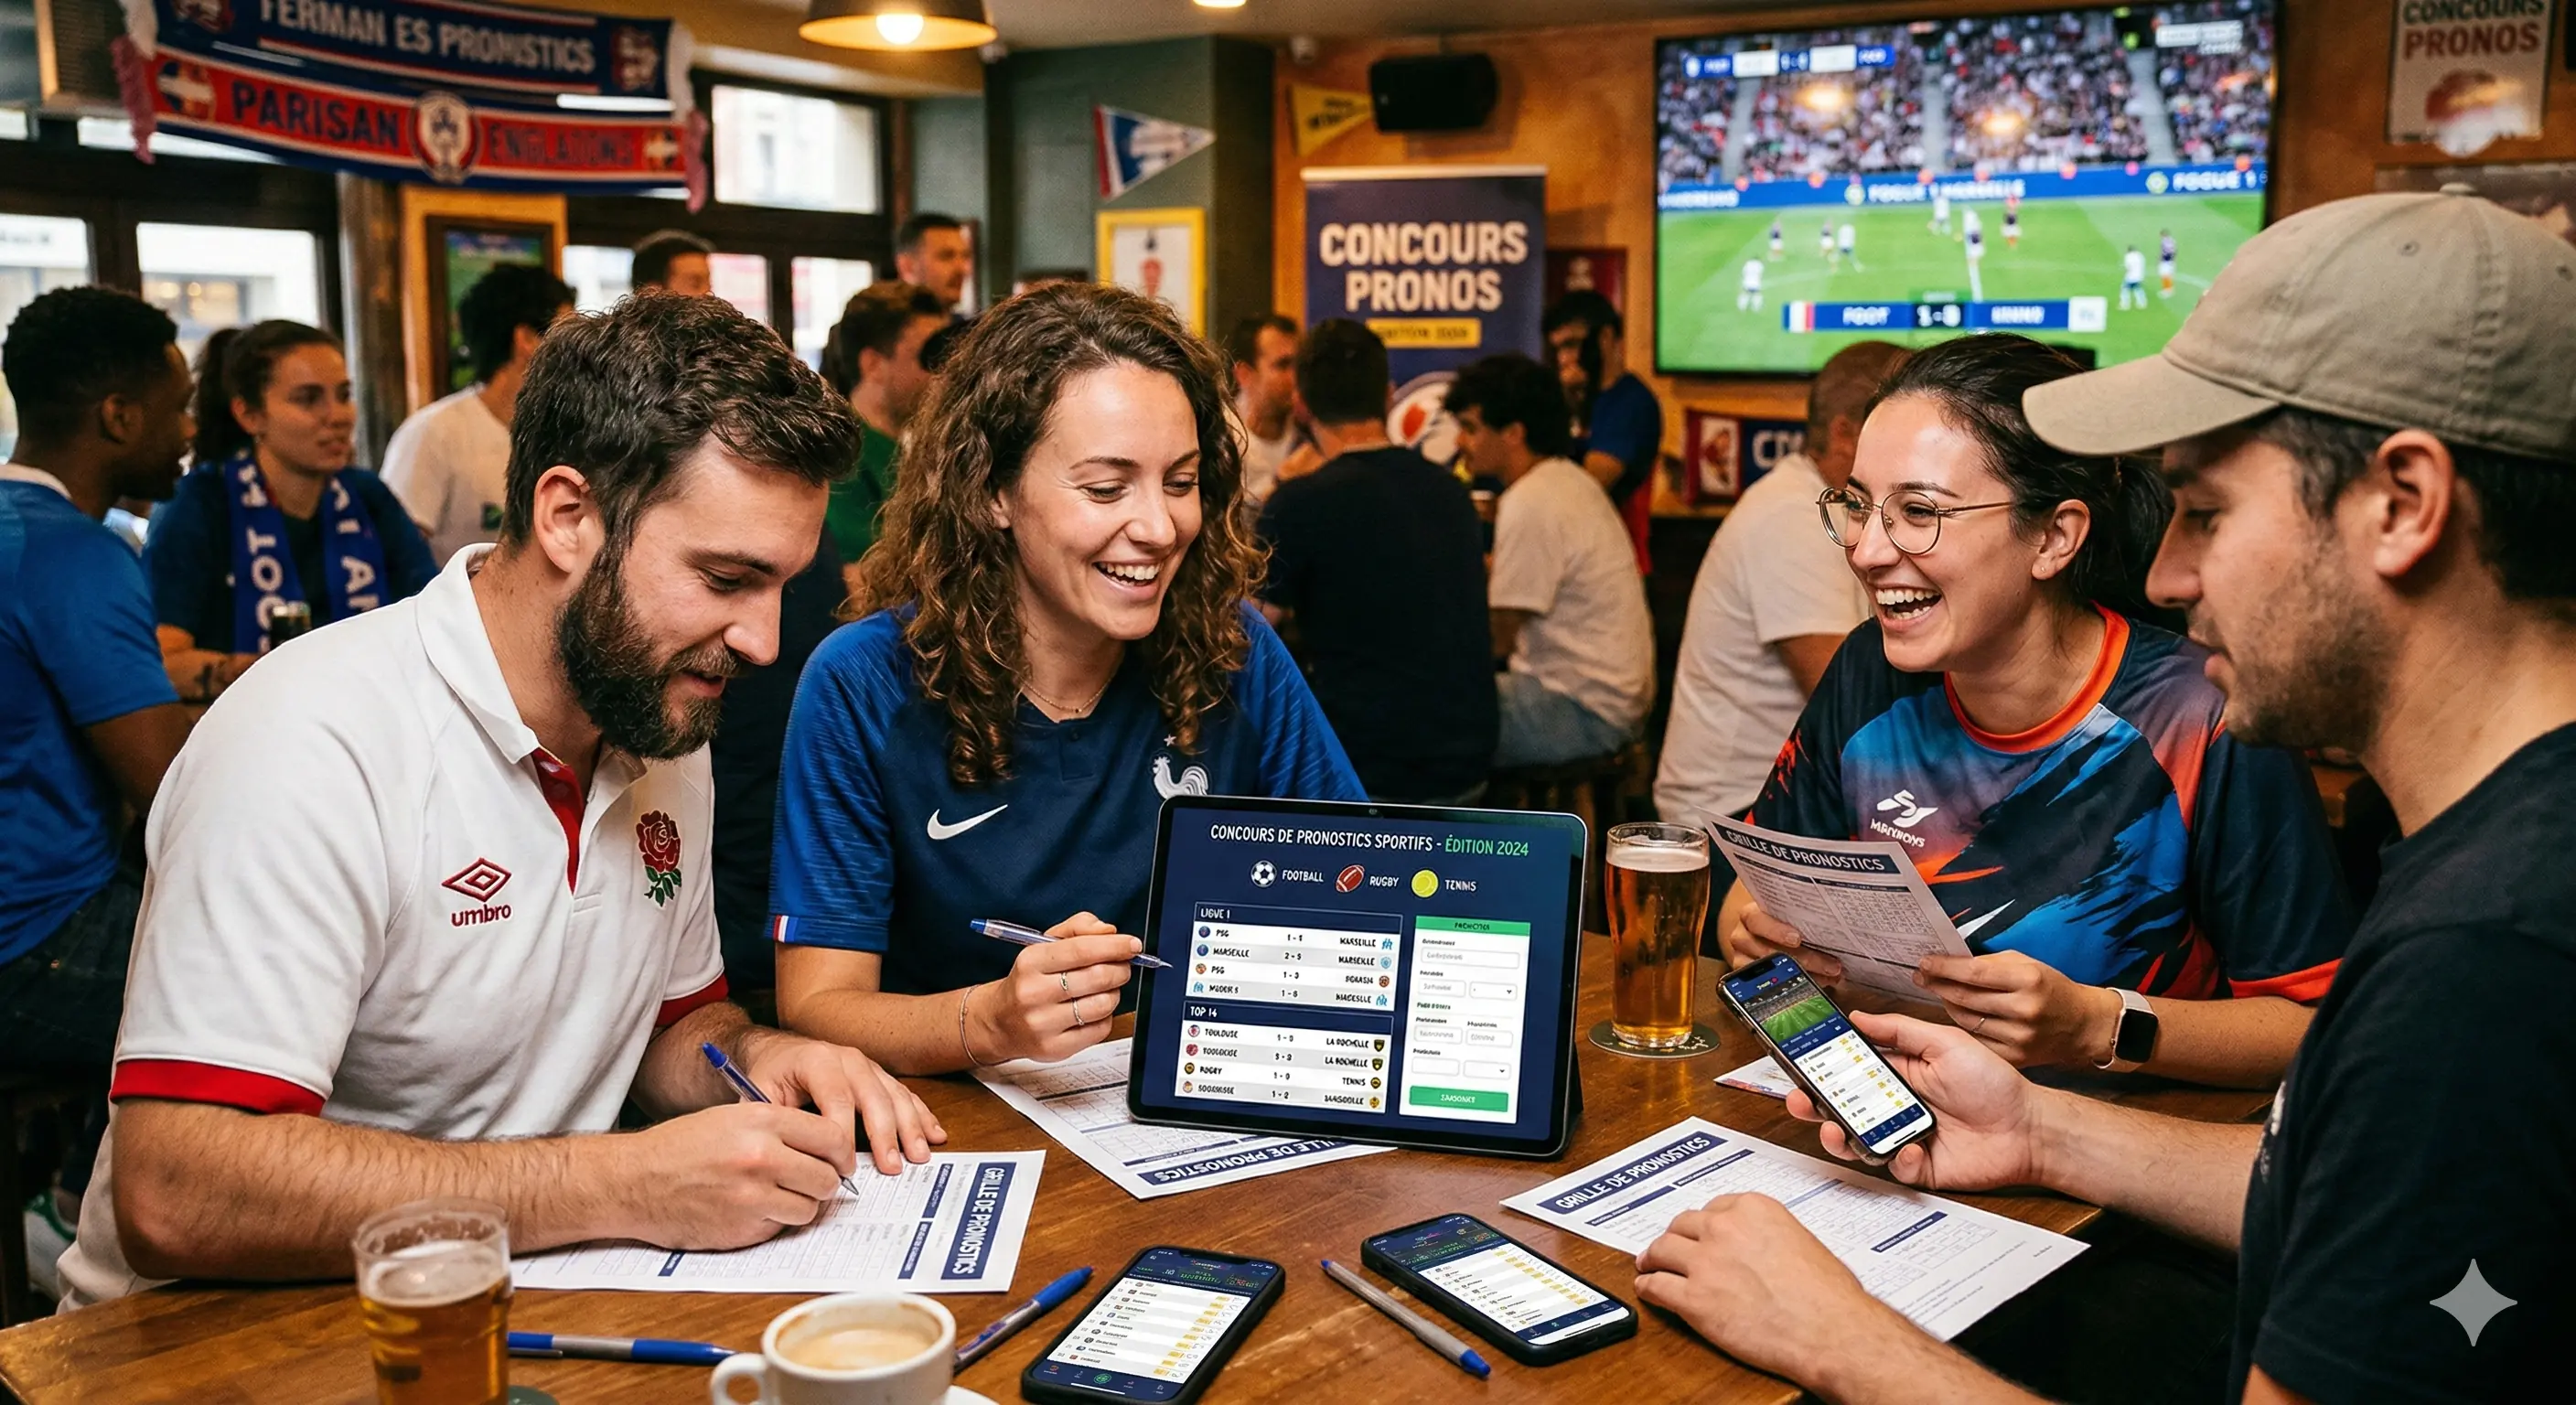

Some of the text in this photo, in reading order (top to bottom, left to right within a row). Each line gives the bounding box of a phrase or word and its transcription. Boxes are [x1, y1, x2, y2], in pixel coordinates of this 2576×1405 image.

[2403, 21, 2541, 61] PRONOS
[231, 80, 400, 148] PARISAN
[1319, 221, 1529, 267] CONCOURS
[1346, 269, 1503, 312] PRONOS
[1210, 824, 1275, 843] CONCOURS
[1277, 829, 1293, 843] DE
[1296, 830, 1372, 848] PRONOSTICS
[1375, 833, 1433, 851] SPORTIFS
[1444, 834, 1494, 855] ÉDITION
[1497, 841, 1530, 857] 2024
[1771, 844, 1791, 860] DE
[1790, 850, 1885, 871] PRONOSTICS
[1282, 870, 1324, 883] FOOTBALL
[1369, 875, 1400, 888] RUGBY
[452, 904, 511, 927] umbro
[1216, 929, 1229, 938] PSG
[1190, 1006, 1206, 1016] TOP
[1272, 1142, 1296, 1158] DE
[1154, 1152, 1268, 1182] PRONOSTICS
[1555, 1184, 1608, 1209] GRILLE
[1605, 1173, 1633, 1188] DE
[1626, 1136, 1711, 1179] PRONOSTICS
[971, 1199, 996, 1213] DE
[951, 1213, 993, 1275] PRONOSTICS
